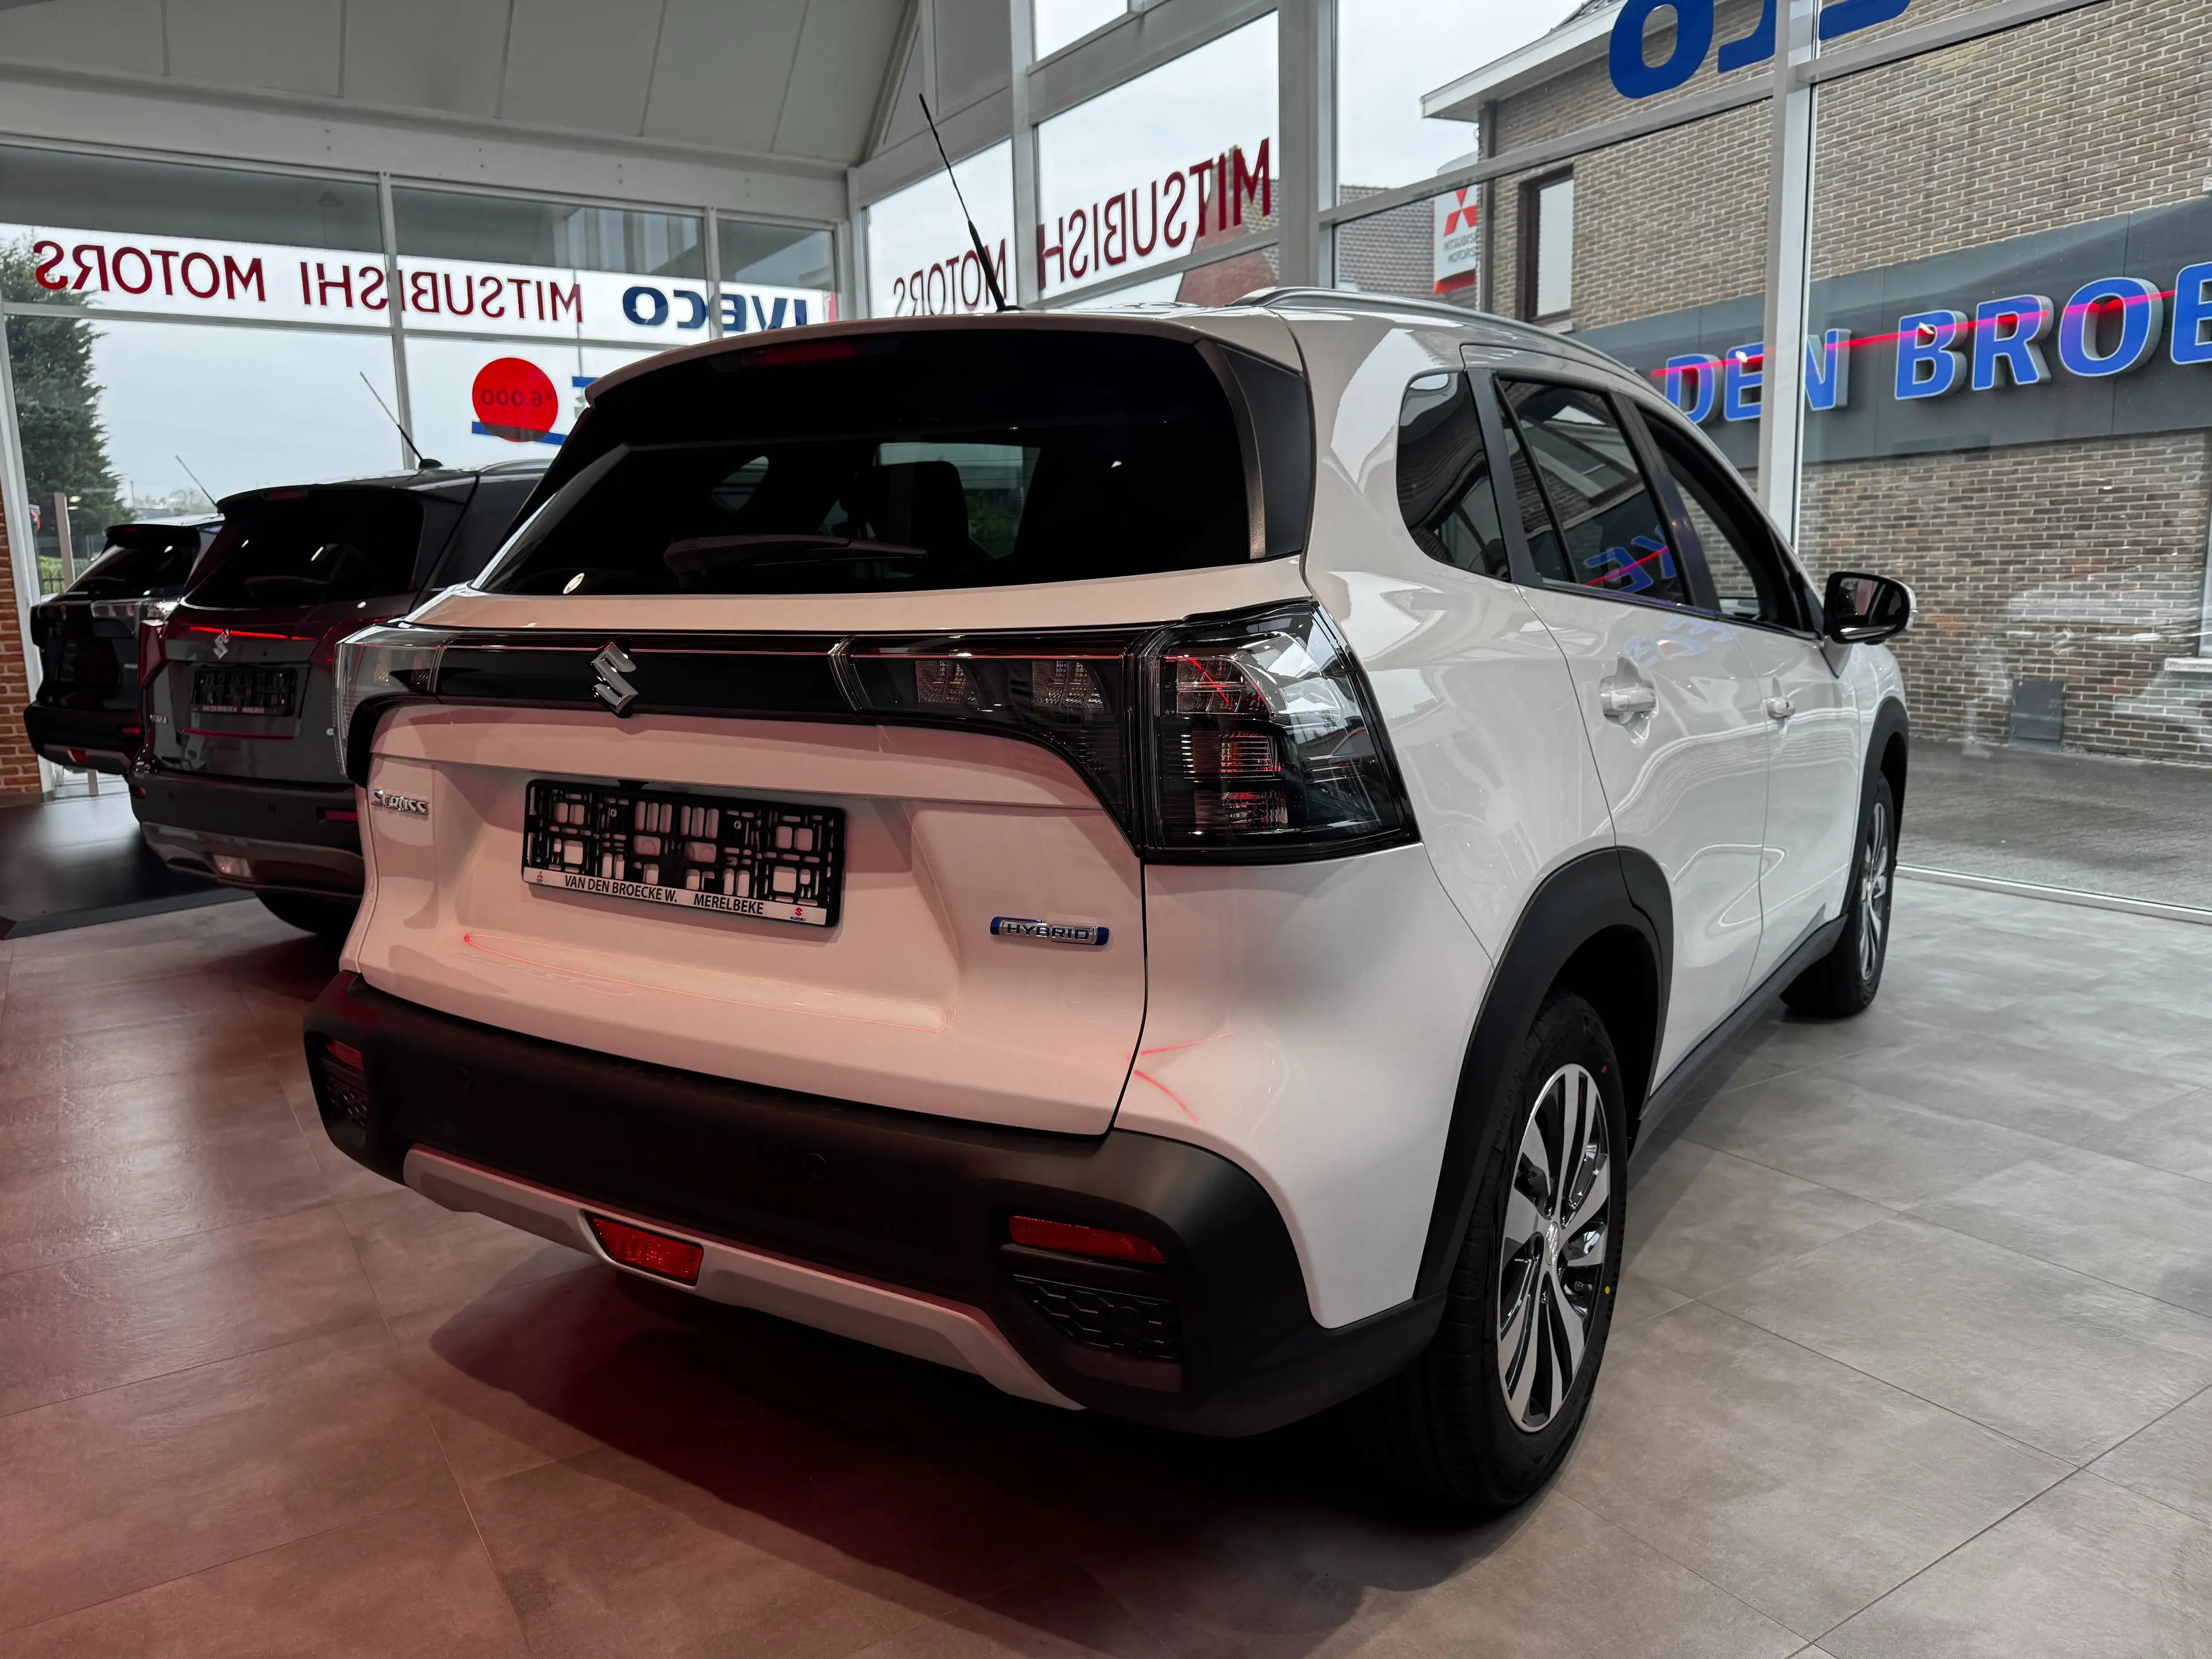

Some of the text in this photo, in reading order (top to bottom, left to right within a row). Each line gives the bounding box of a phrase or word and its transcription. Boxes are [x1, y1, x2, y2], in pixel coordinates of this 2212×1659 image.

[565, 874, 764, 915] VAN DEN BROECKE W. MERELBEKE
[1006, 923, 1090, 940] HYBRID
